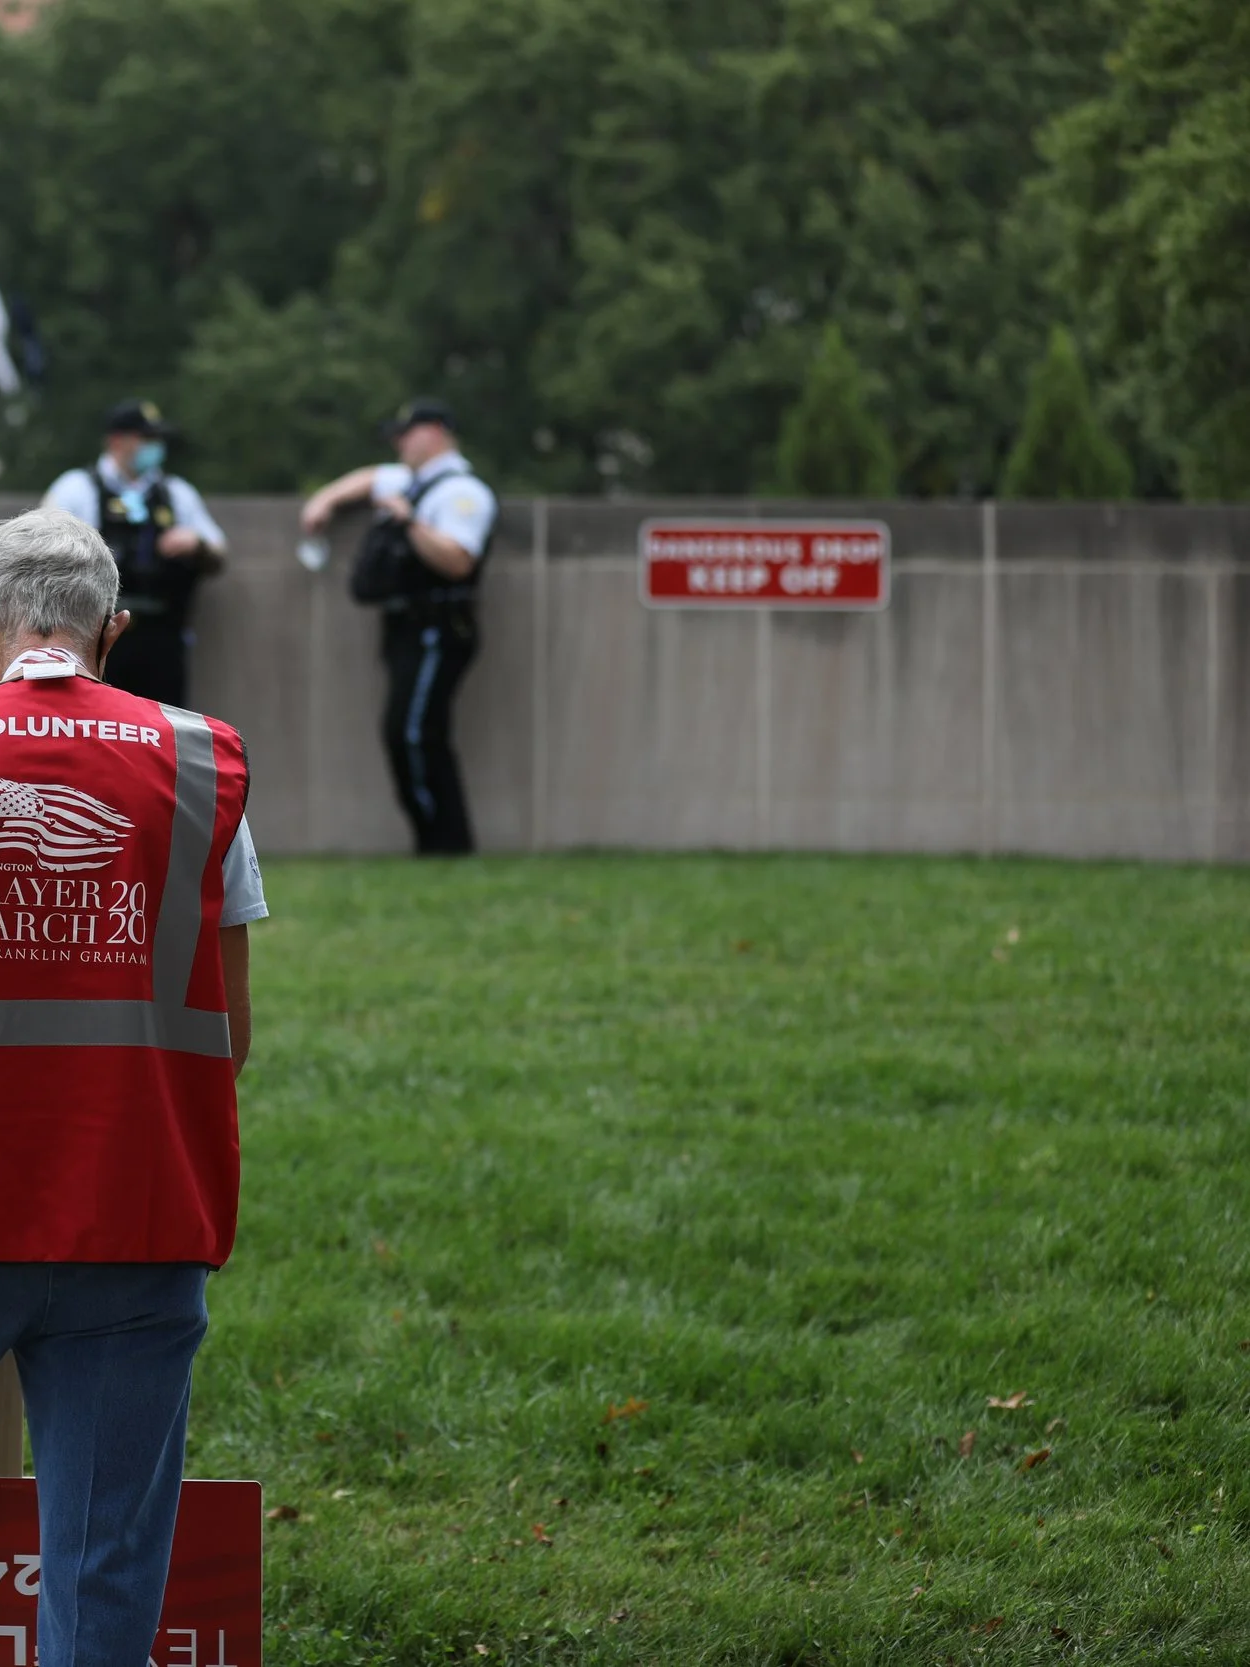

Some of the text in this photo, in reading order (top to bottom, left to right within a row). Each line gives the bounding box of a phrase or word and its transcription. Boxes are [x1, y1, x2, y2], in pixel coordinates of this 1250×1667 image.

[688, 565, 840, 594] KEEP OFF
[108, 880, 146, 916] 20
[106, 911, 146, 945] 20
[80, 950, 147, 966] GRAHAM
